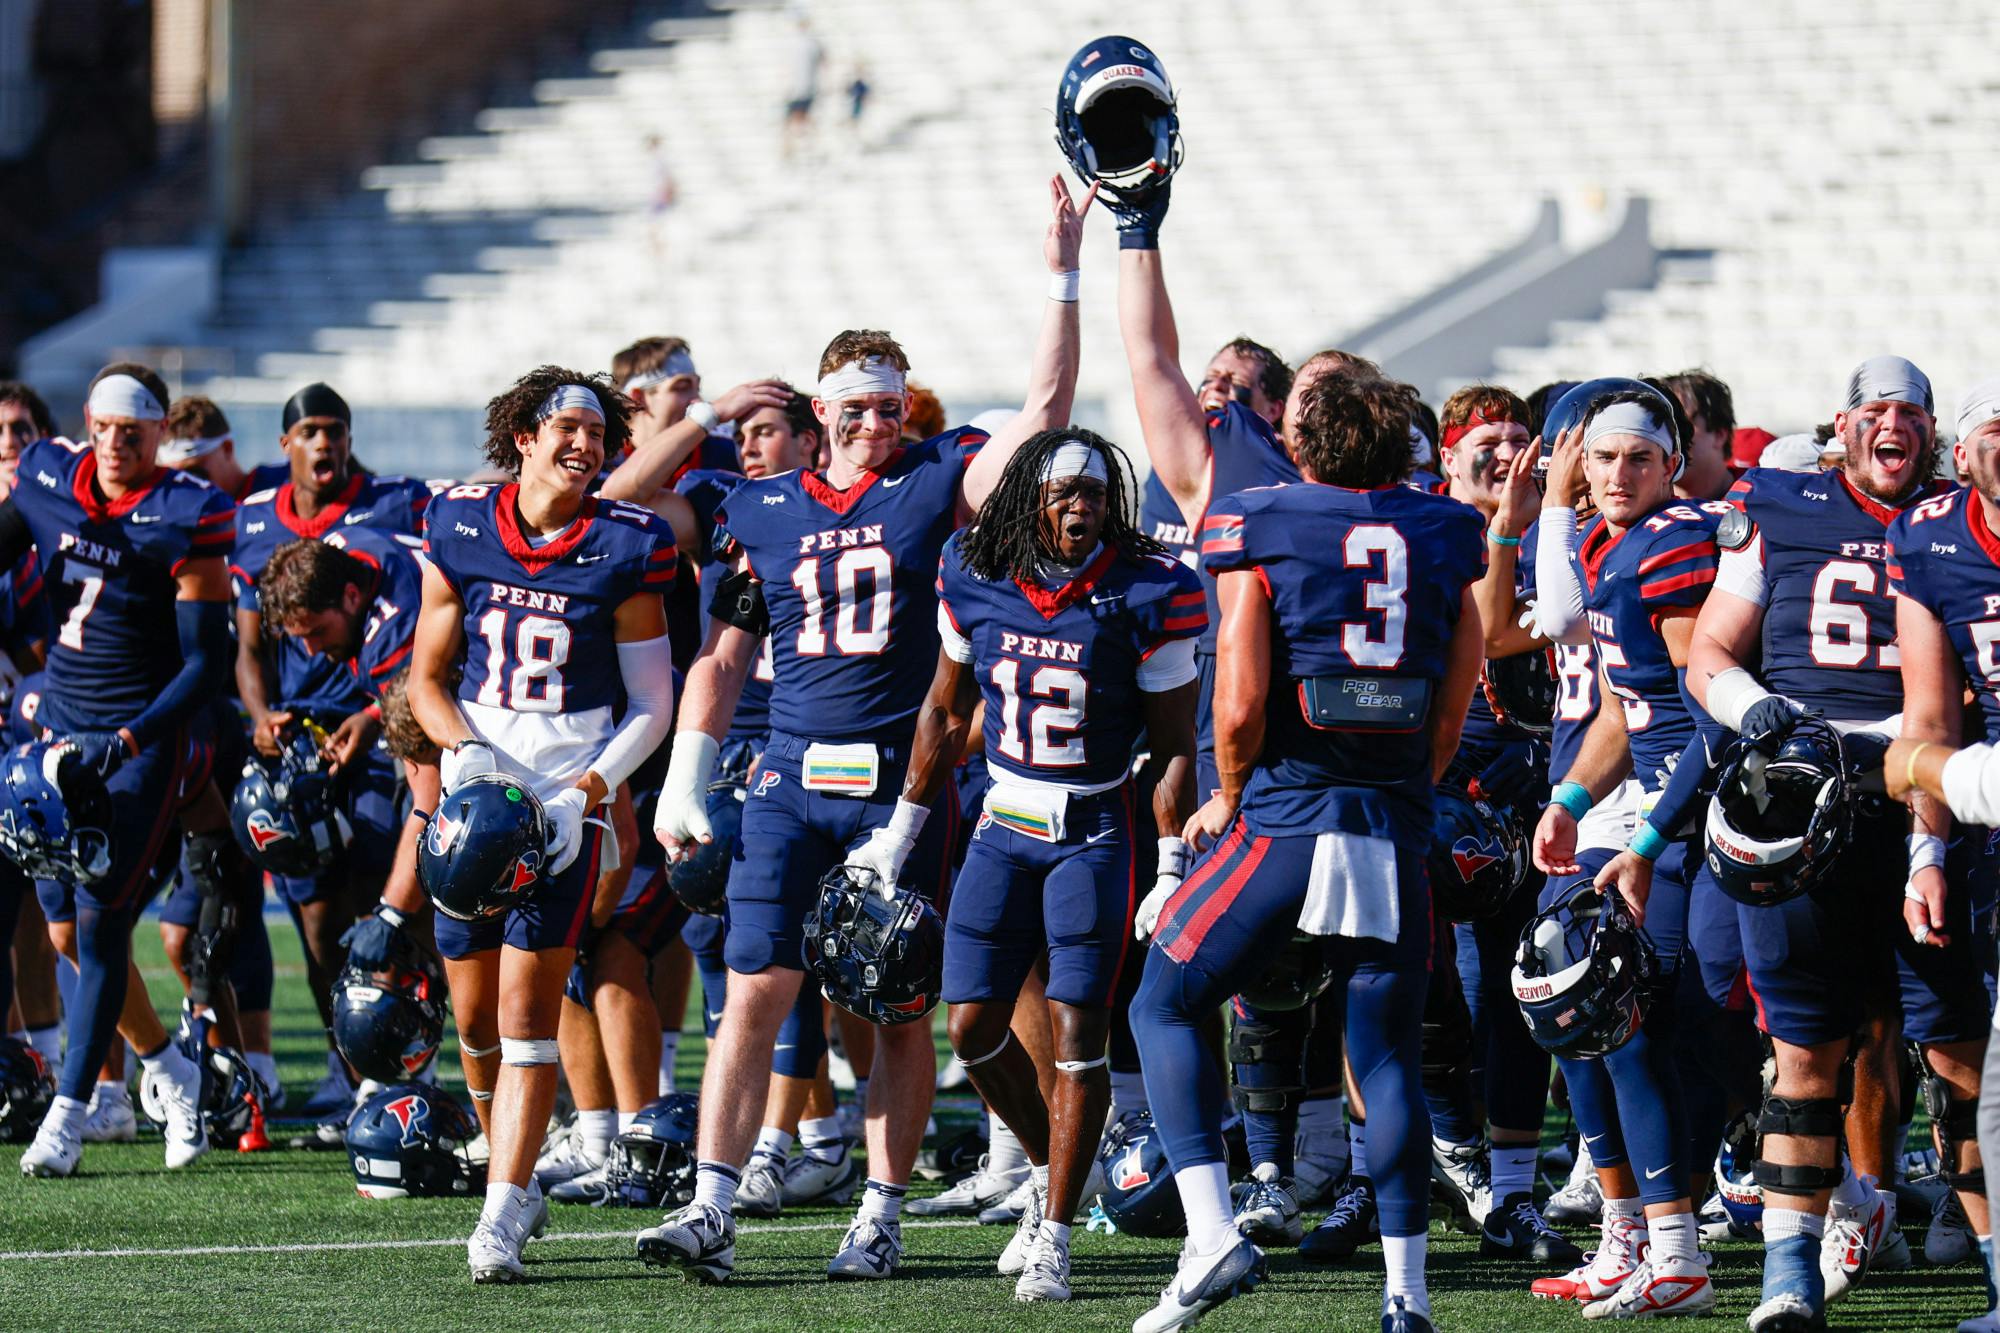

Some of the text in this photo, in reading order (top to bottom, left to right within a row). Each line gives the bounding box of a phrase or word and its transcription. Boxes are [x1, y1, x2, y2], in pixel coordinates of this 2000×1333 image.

[1103, 66, 1145, 80] QUAKERS
[1803, 489, 1819, 501] Ivy
[455, 522, 471, 536] Ivy
[800, 524, 885, 553] PENN
[59, 532, 122, 567] PENN
[1840, 543, 1888, 560] PE
[1931, 542, 1947, 554] Ivy
[59, 556, 104, 652] 7
[490, 583, 570, 614] PENN
[791, 546, 895, 656] 10
[1341, 523, 1409, 669] 3
[1587, 608, 1615, 638] PENN
[477, 608, 573, 713] 18
[1001, 632, 1084, 663] PENN
[1342, 680, 1379, 694] PRO
[1355, 693, 1402, 708] GEAR
[991, 657, 1089, 768] 12
[1715, 833, 1757, 864] QUAKERS
[1516, 982, 1553, 999] QUAKERS
